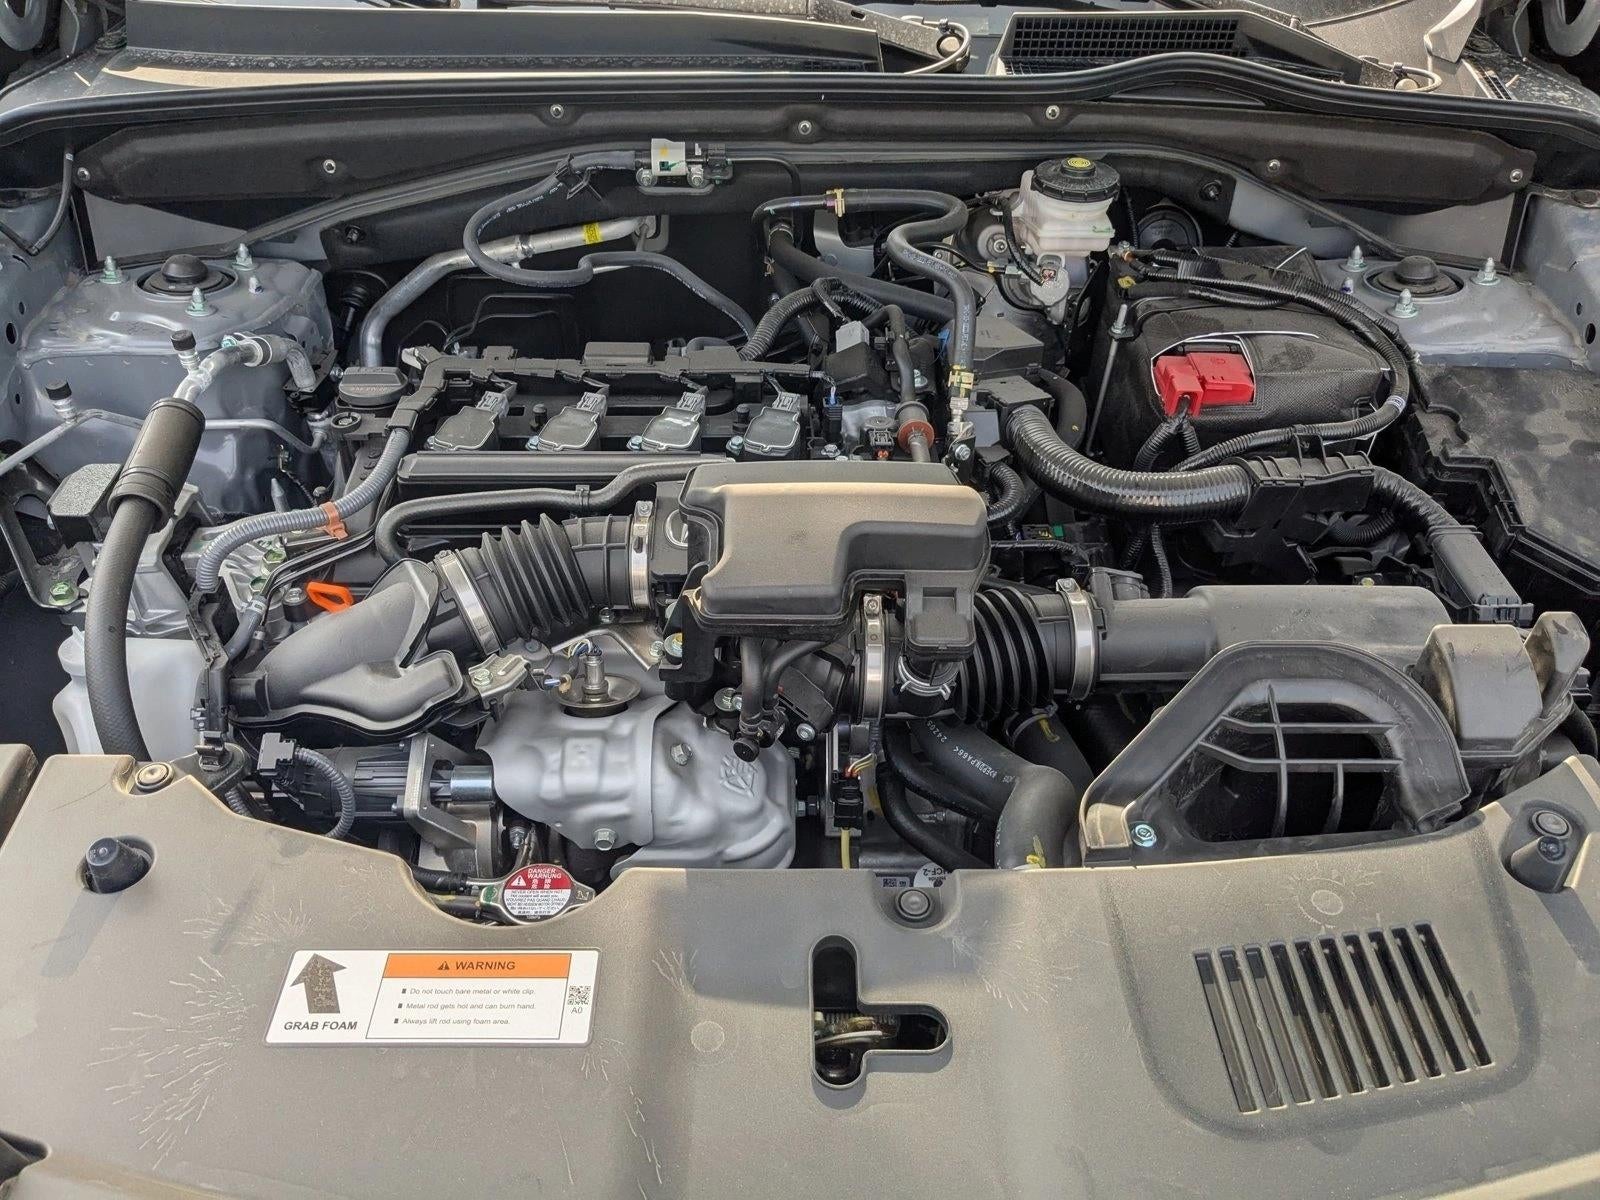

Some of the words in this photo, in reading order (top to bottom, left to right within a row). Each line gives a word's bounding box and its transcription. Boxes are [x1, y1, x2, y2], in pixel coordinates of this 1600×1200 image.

[456, 961, 516, 970] WARNING
[284, 1021, 319, 1030] GRAB
[322, 1021, 358, 1030] FOAM
